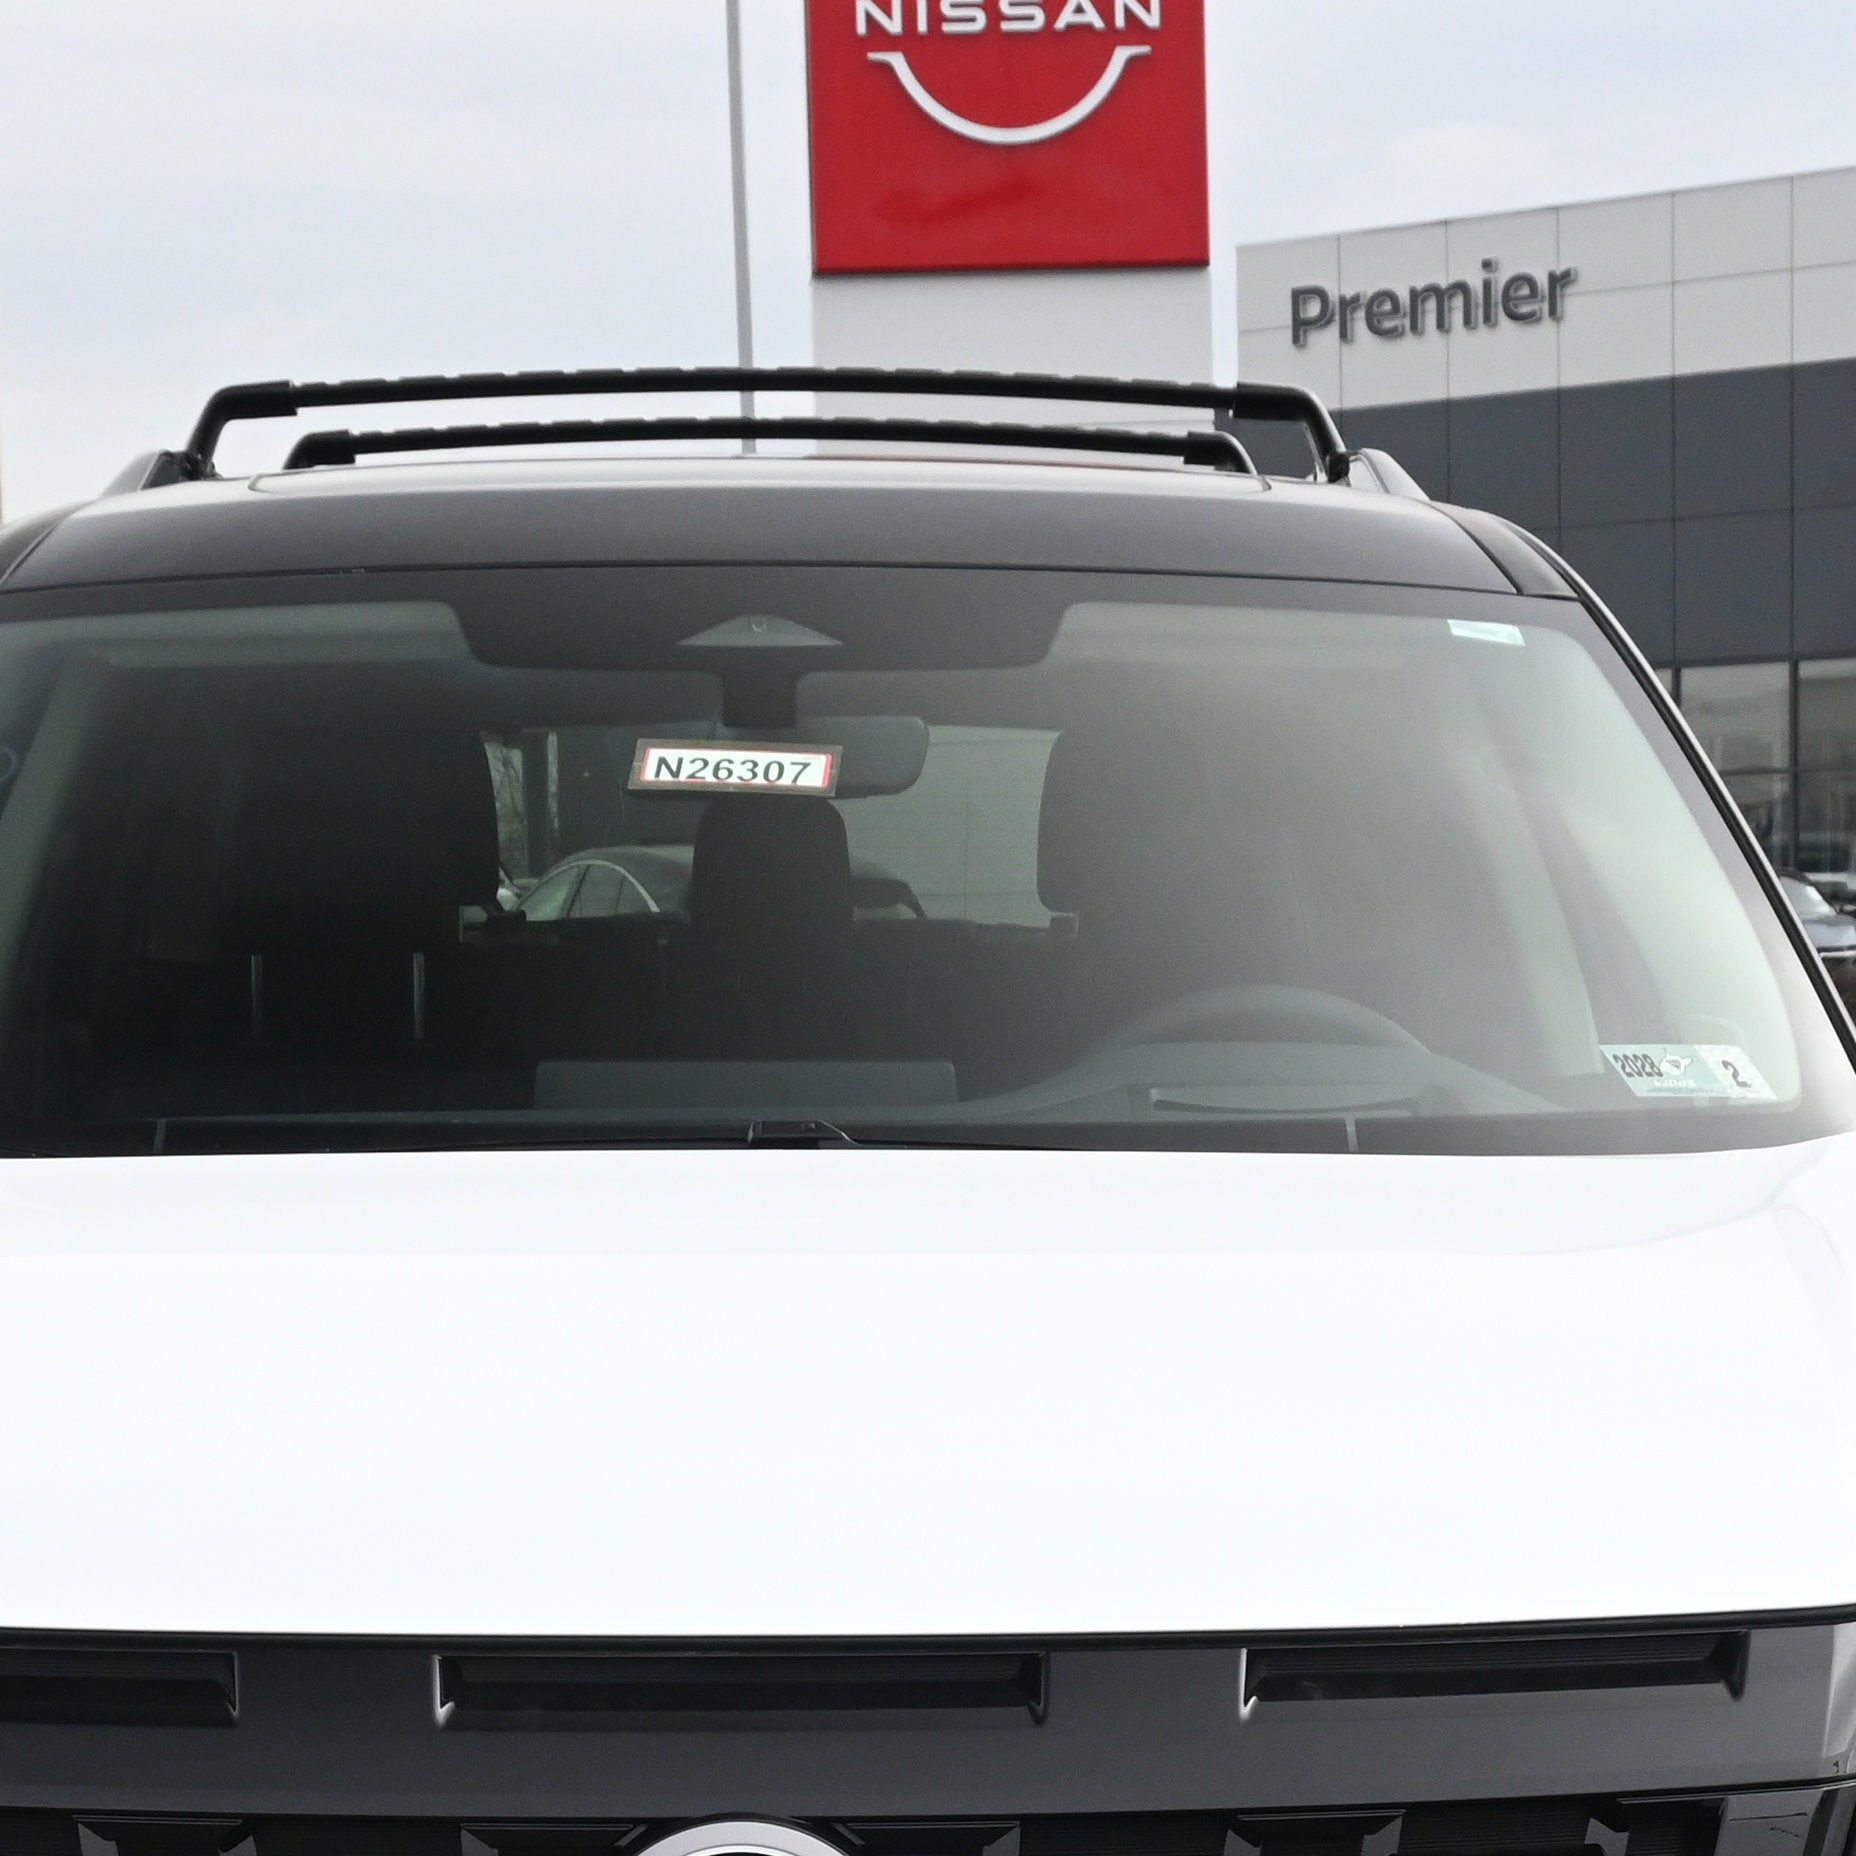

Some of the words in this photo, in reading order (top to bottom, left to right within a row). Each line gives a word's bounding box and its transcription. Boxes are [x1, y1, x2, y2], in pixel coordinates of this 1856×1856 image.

[855, 0, 1162, 36] NISSAN
[1290, 257, 1579, 348] Premier
[653, 756, 812, 785] N26307
[1612, 1053, 1664, 1078] 2028
[1721, 1059, 1752, 1088] 2
